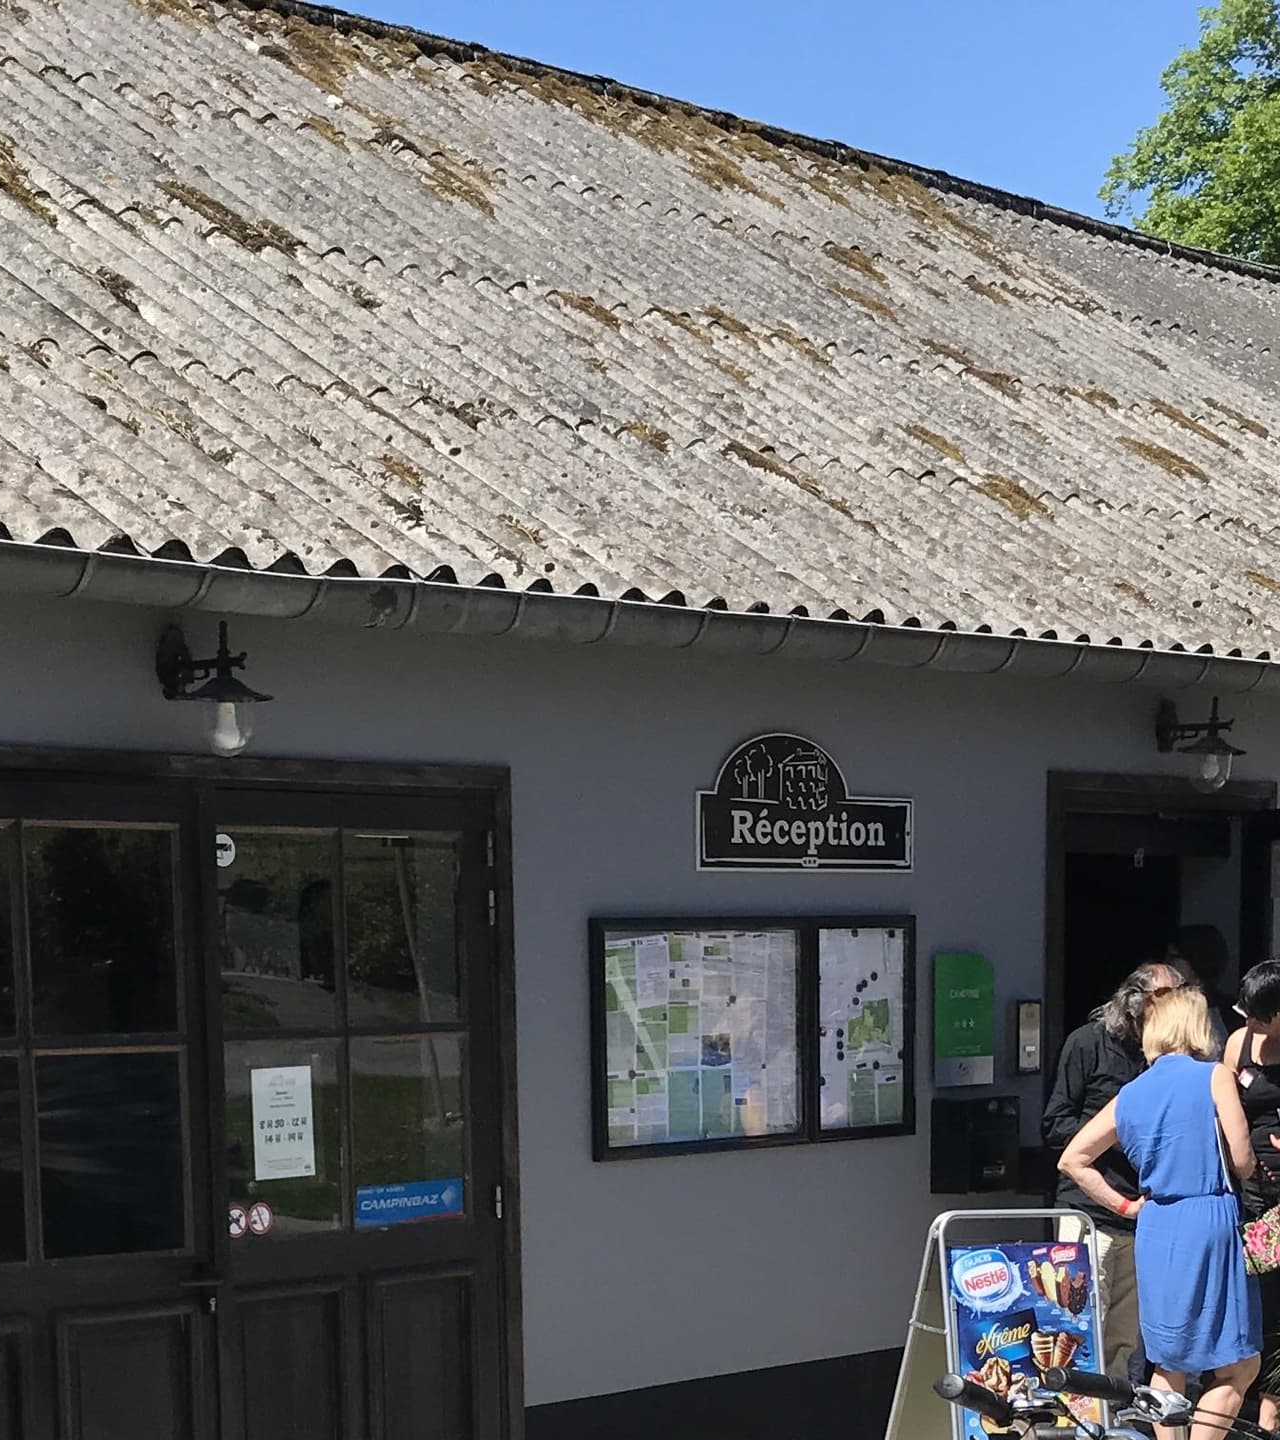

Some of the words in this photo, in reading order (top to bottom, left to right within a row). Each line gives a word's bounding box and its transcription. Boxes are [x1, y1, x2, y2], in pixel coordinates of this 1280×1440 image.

[731, 808, 885, 855] Réception
[360, 1193, 439, 1211] CAMPINGAZ
[964, 1267, 1008, 1292] Nestlé
